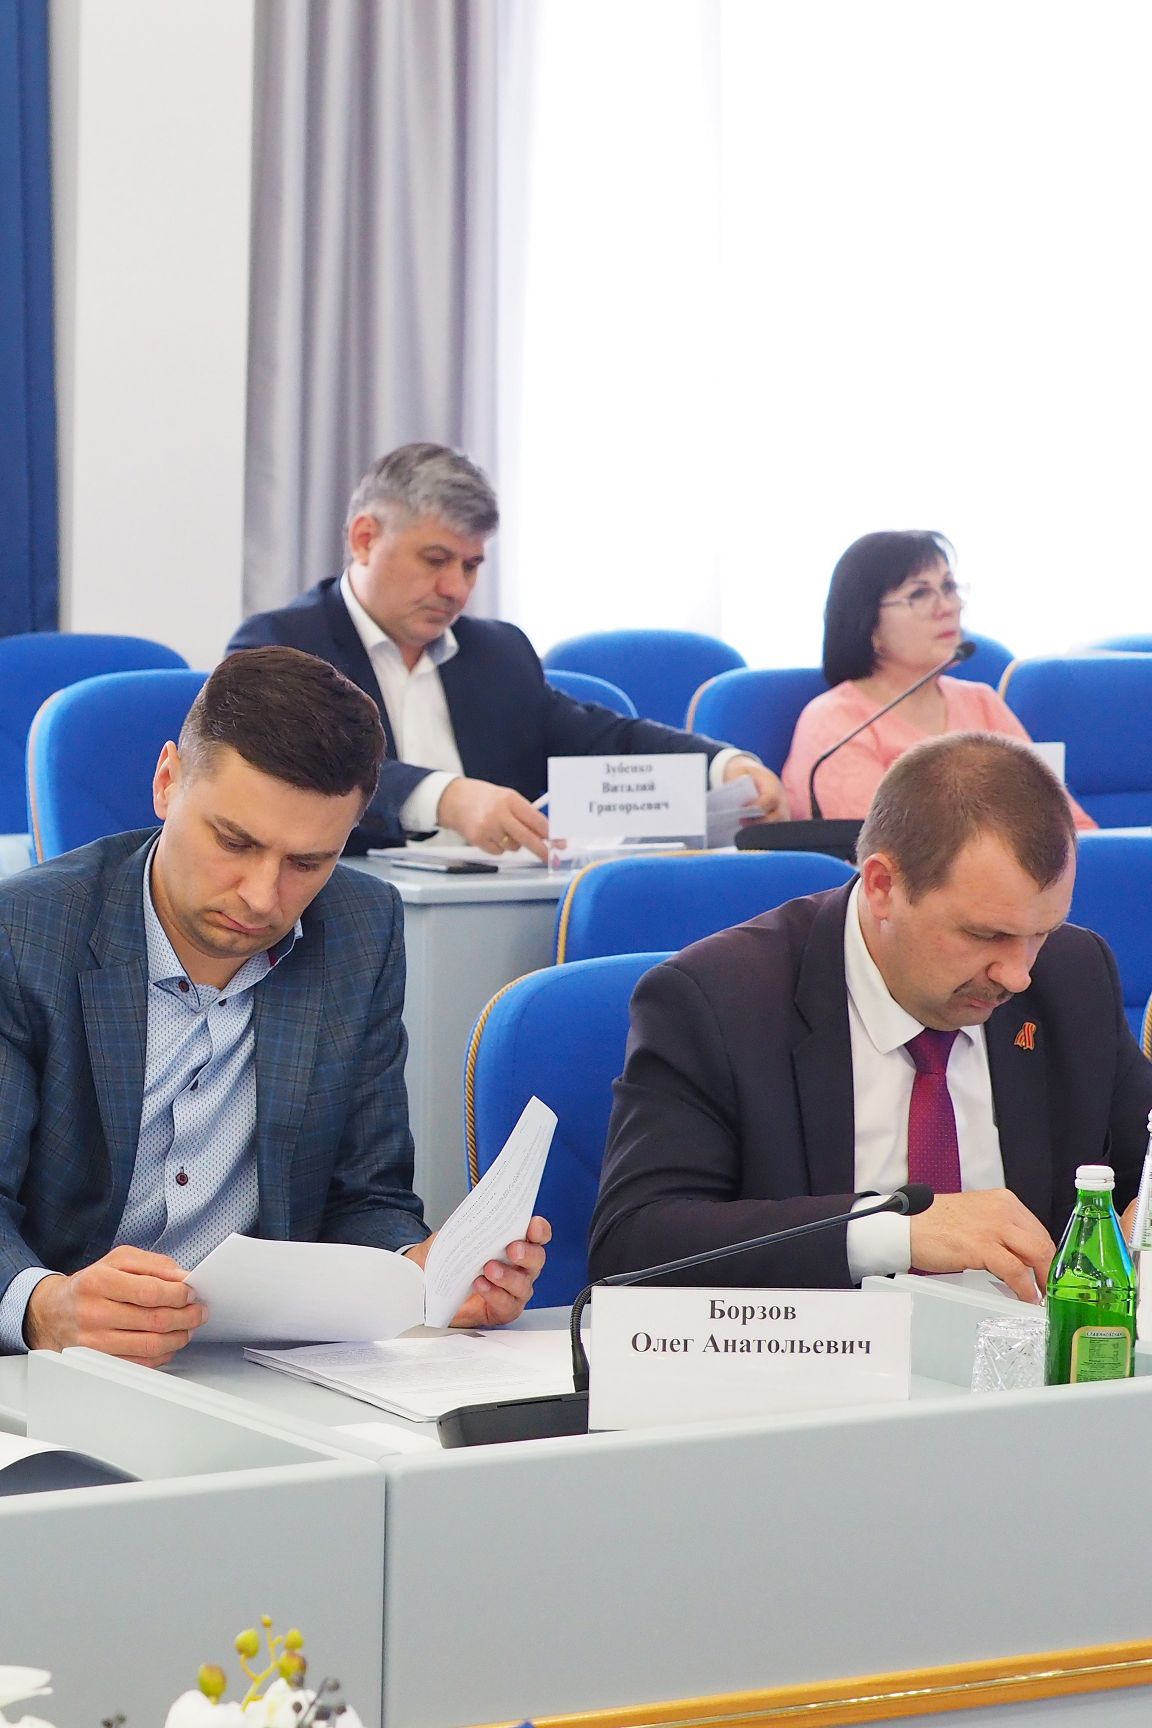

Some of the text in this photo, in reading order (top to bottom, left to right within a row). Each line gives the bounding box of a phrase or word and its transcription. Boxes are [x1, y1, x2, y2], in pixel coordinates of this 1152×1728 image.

[708, 1299, 797, 1325] Борзов
[630, 1331, 872, 1355] Олег Анатольевич
